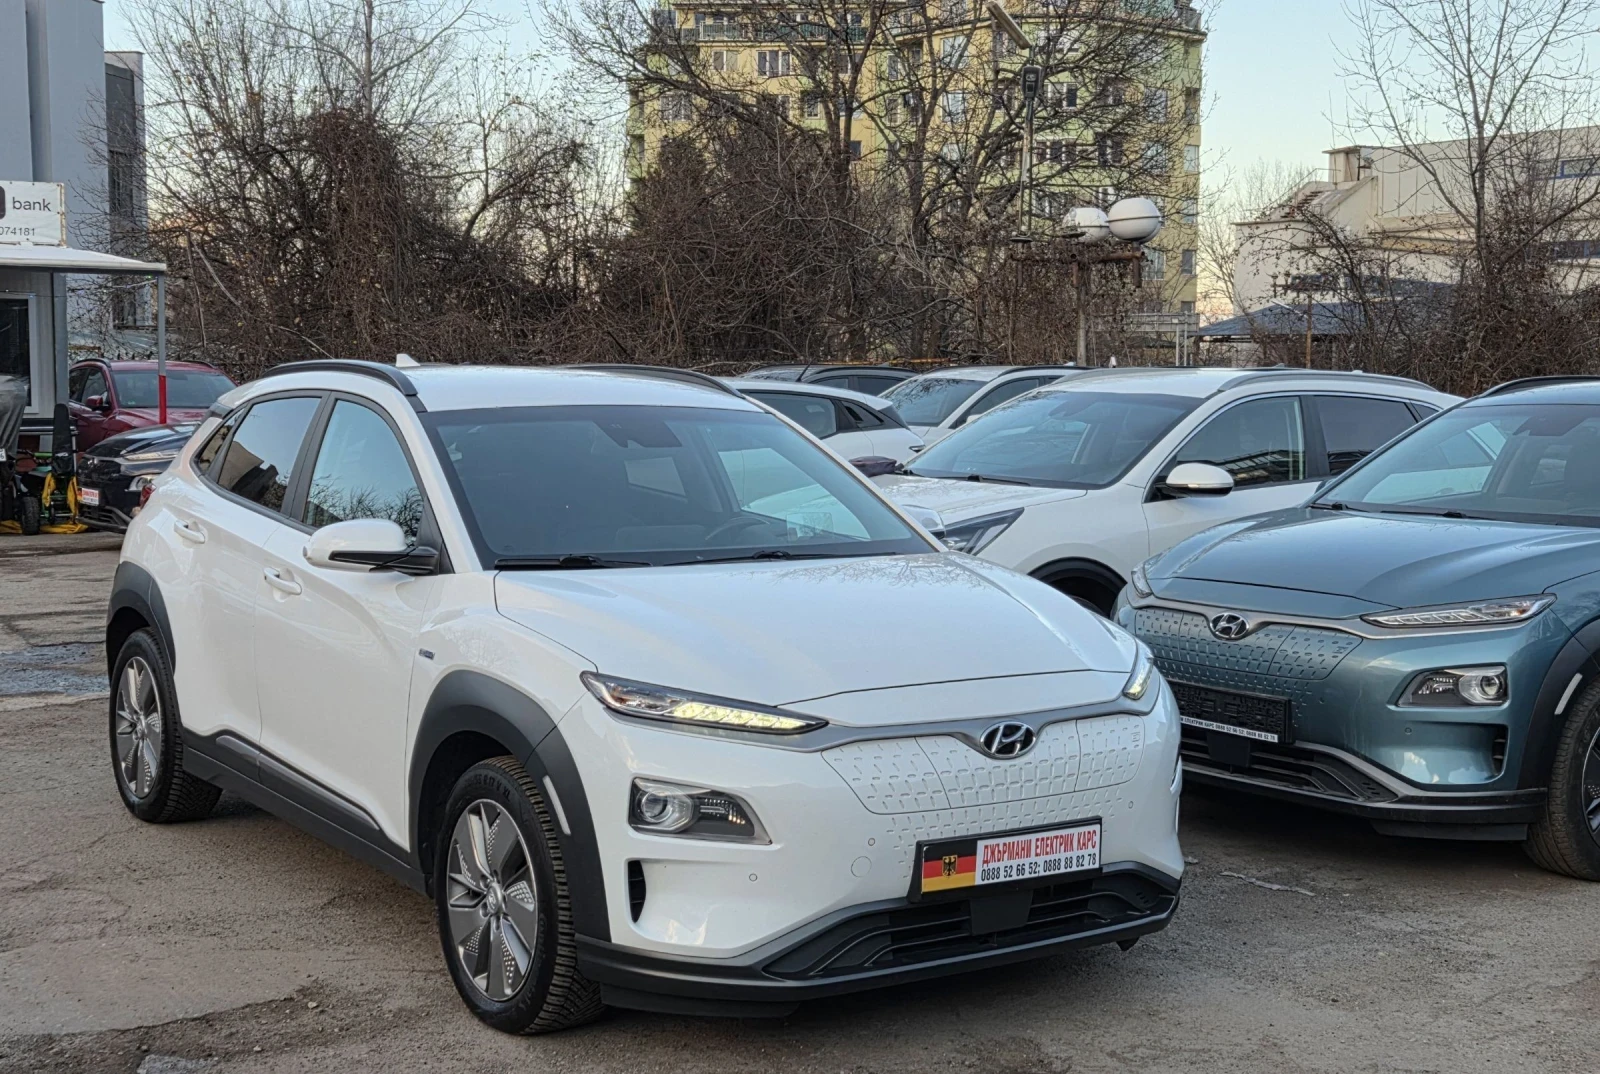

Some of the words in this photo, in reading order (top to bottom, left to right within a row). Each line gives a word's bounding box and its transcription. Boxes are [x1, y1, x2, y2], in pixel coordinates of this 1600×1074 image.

[12, 196, 51, 212] bank
[982, 839, 1032, 866] ДЖЪРМАНИ
[1034, 832, 1075, 857] ЕЛЕКТРИК
[1077, 829, 1097, 850] КАРС
[981, 867, 1001, 882] 0888
[1003, 865, 1013, 878] 52
[1016, 863, 1026, 877] 66
[1043, 857, 1062, 873] 0888
[1064, 856, 1073, 869] 88
[1075, 854, 1085, 868] 82
[1087, 852, 1097, 866] 78
